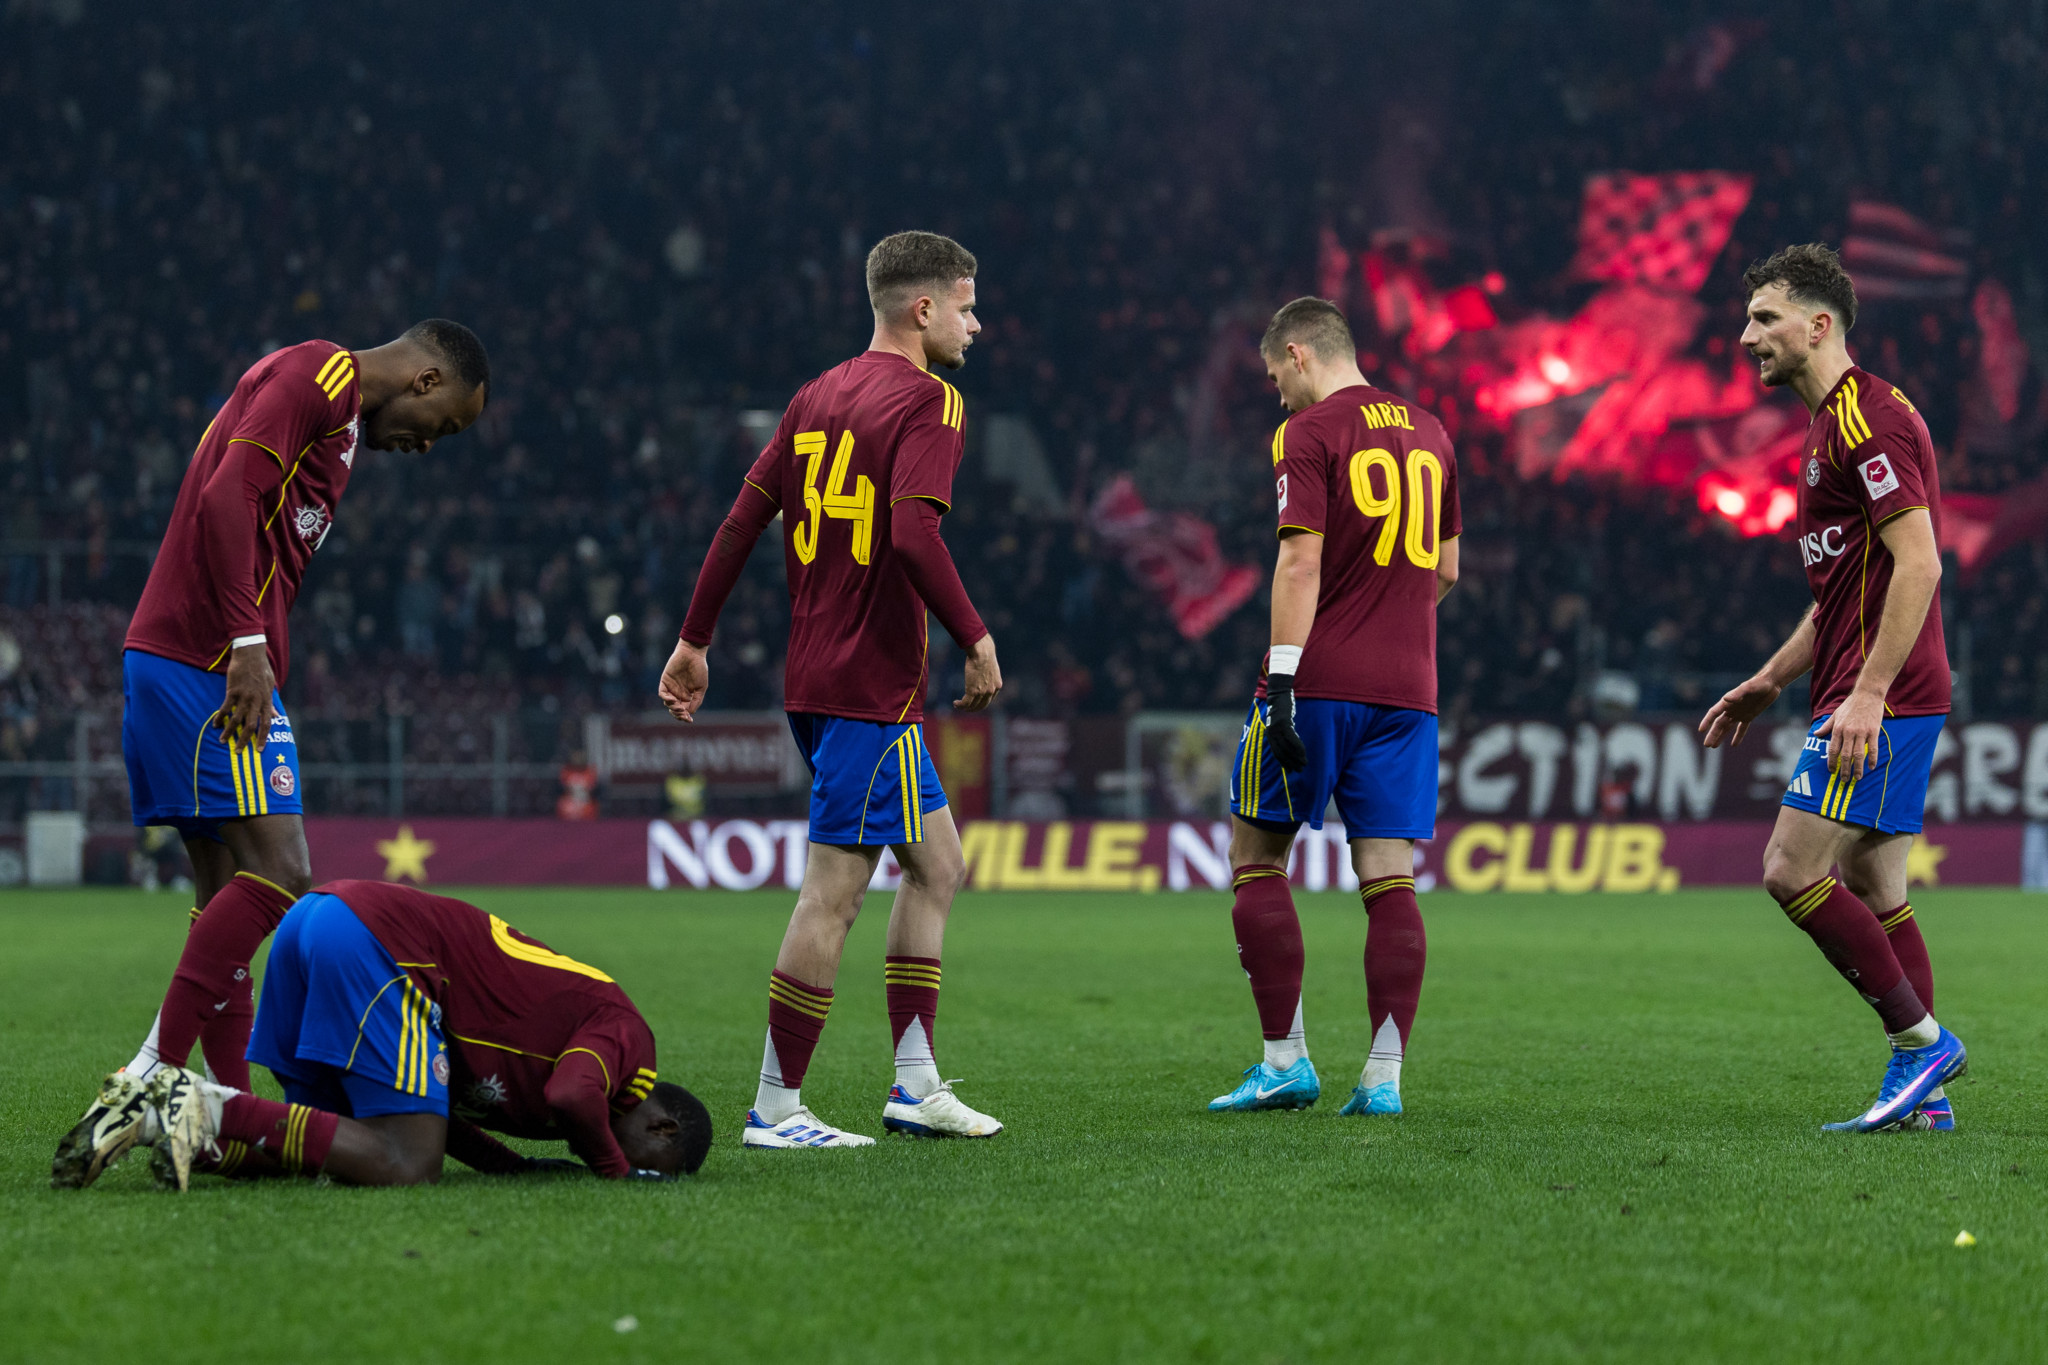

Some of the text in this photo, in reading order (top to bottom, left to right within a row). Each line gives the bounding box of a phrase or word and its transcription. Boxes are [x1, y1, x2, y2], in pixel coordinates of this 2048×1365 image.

[793, 430, 875, 565] 34
[1349, 448, 1442, 570] 90
[1799, 525, 1846, 567] MSC
